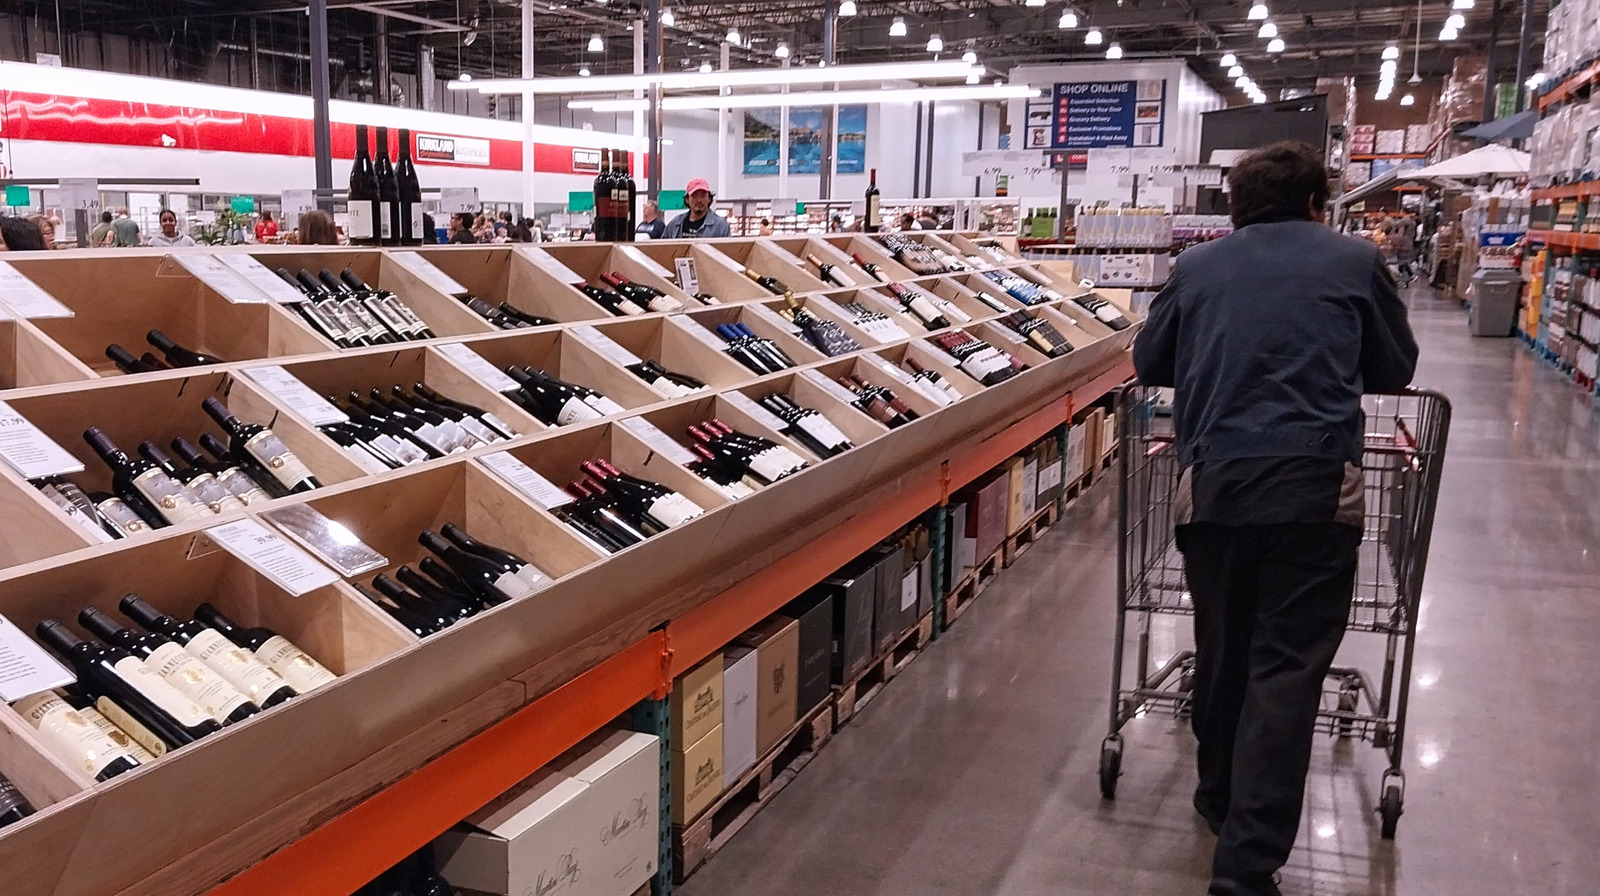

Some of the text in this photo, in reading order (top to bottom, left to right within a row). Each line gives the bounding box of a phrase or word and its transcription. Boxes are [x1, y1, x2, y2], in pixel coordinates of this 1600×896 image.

[1060, 82, 1129, 94] SHOP ONLINE
[419, 137, 454, 153] KIRKLAND
[574, 151, 599, 164] KIRKLAND
[81, 199, 99, 209] 3.49
[460, 203, 475, 212] 7.99
